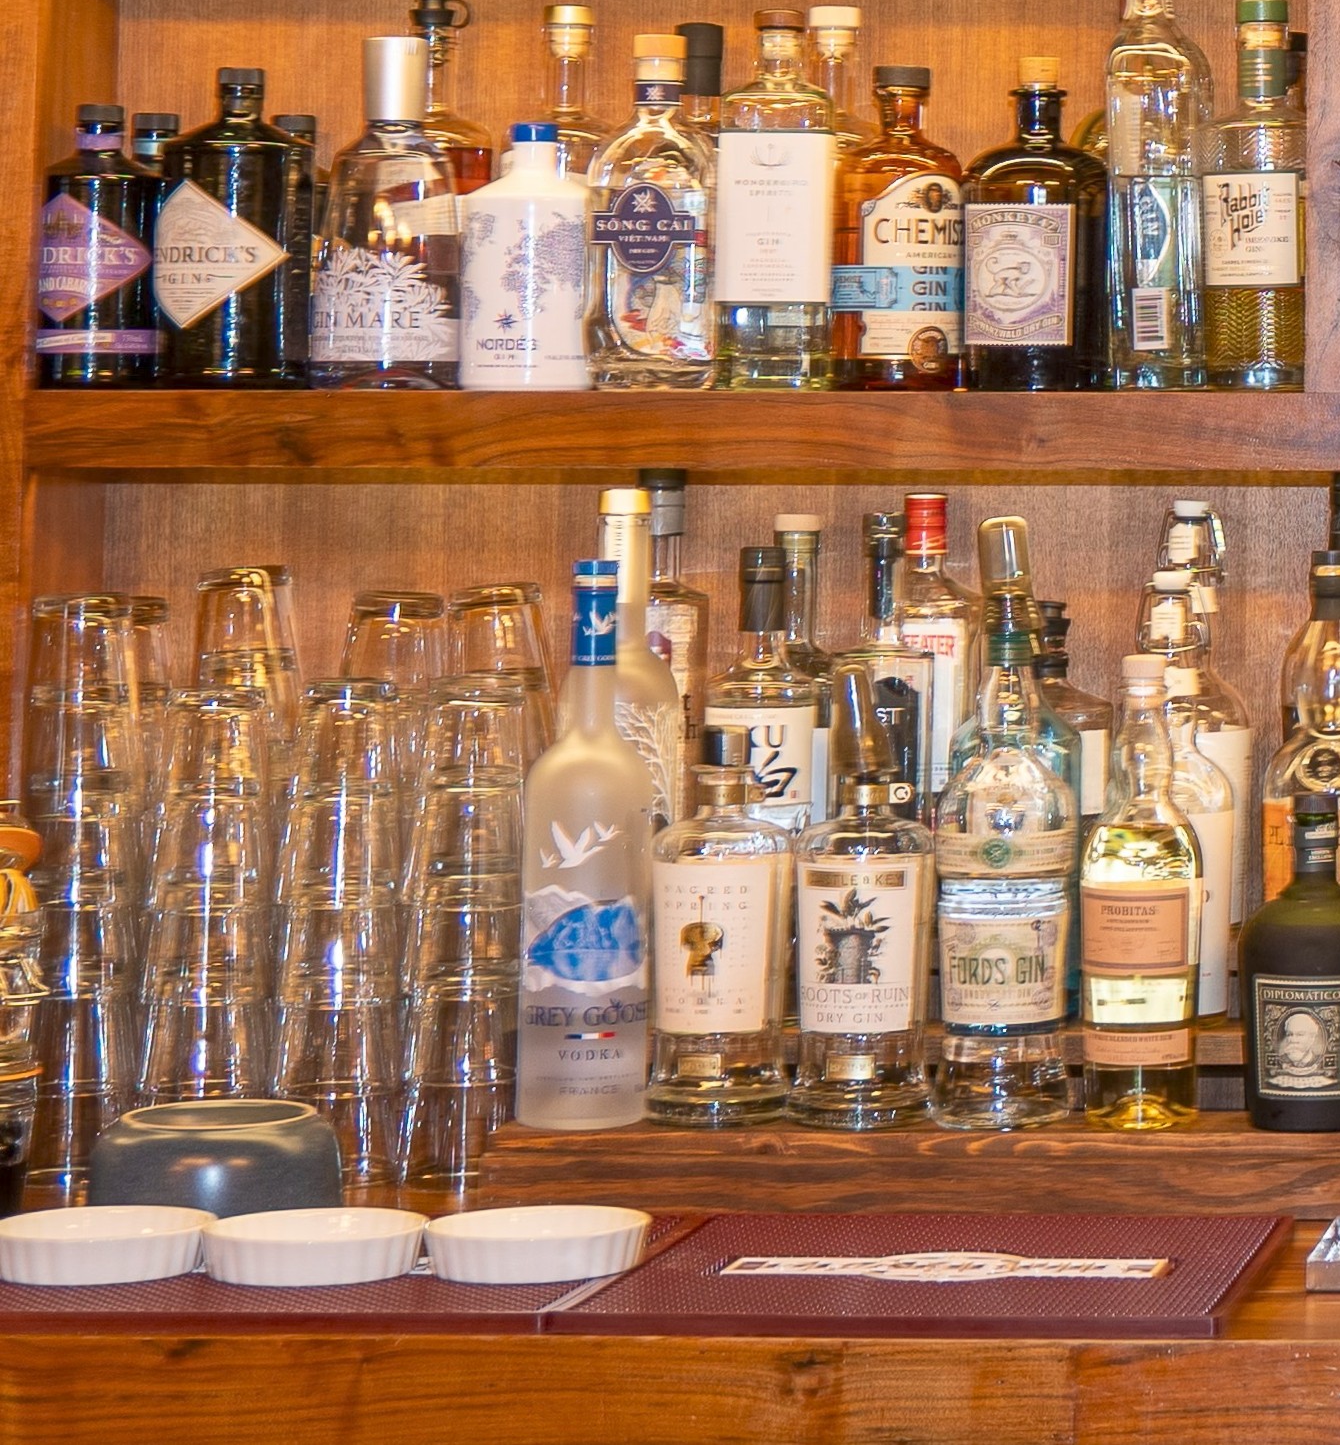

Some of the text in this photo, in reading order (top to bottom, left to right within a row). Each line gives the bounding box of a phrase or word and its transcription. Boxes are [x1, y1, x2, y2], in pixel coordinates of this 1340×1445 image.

[1217, 182, 1270, 227] Rabbit
[971, 209, 1058, 231] MONKEY 47
[1230, 210, 1263, 251] Hole
[167, 272, 203, 285] GIN
[911, 279, 947, 297] GIN
[344, 311, 421, 329] MARE
[662, 883, 749, 896] SACRED
[662, 900, 749, 912] SPRING
[1100, 904, 1156, 917] PROBITAS
[949, 952, 1048, 987] FORDS GIN
[801, 986, 853, 1006] ROOTS
[524, 1004, 578, 1030] GREY
[815, 1011, 884, 1025] DRY GIN
[557, 1048, 624, 1064] VODKA
[558, 1084, 620, 1096] FRANCE
